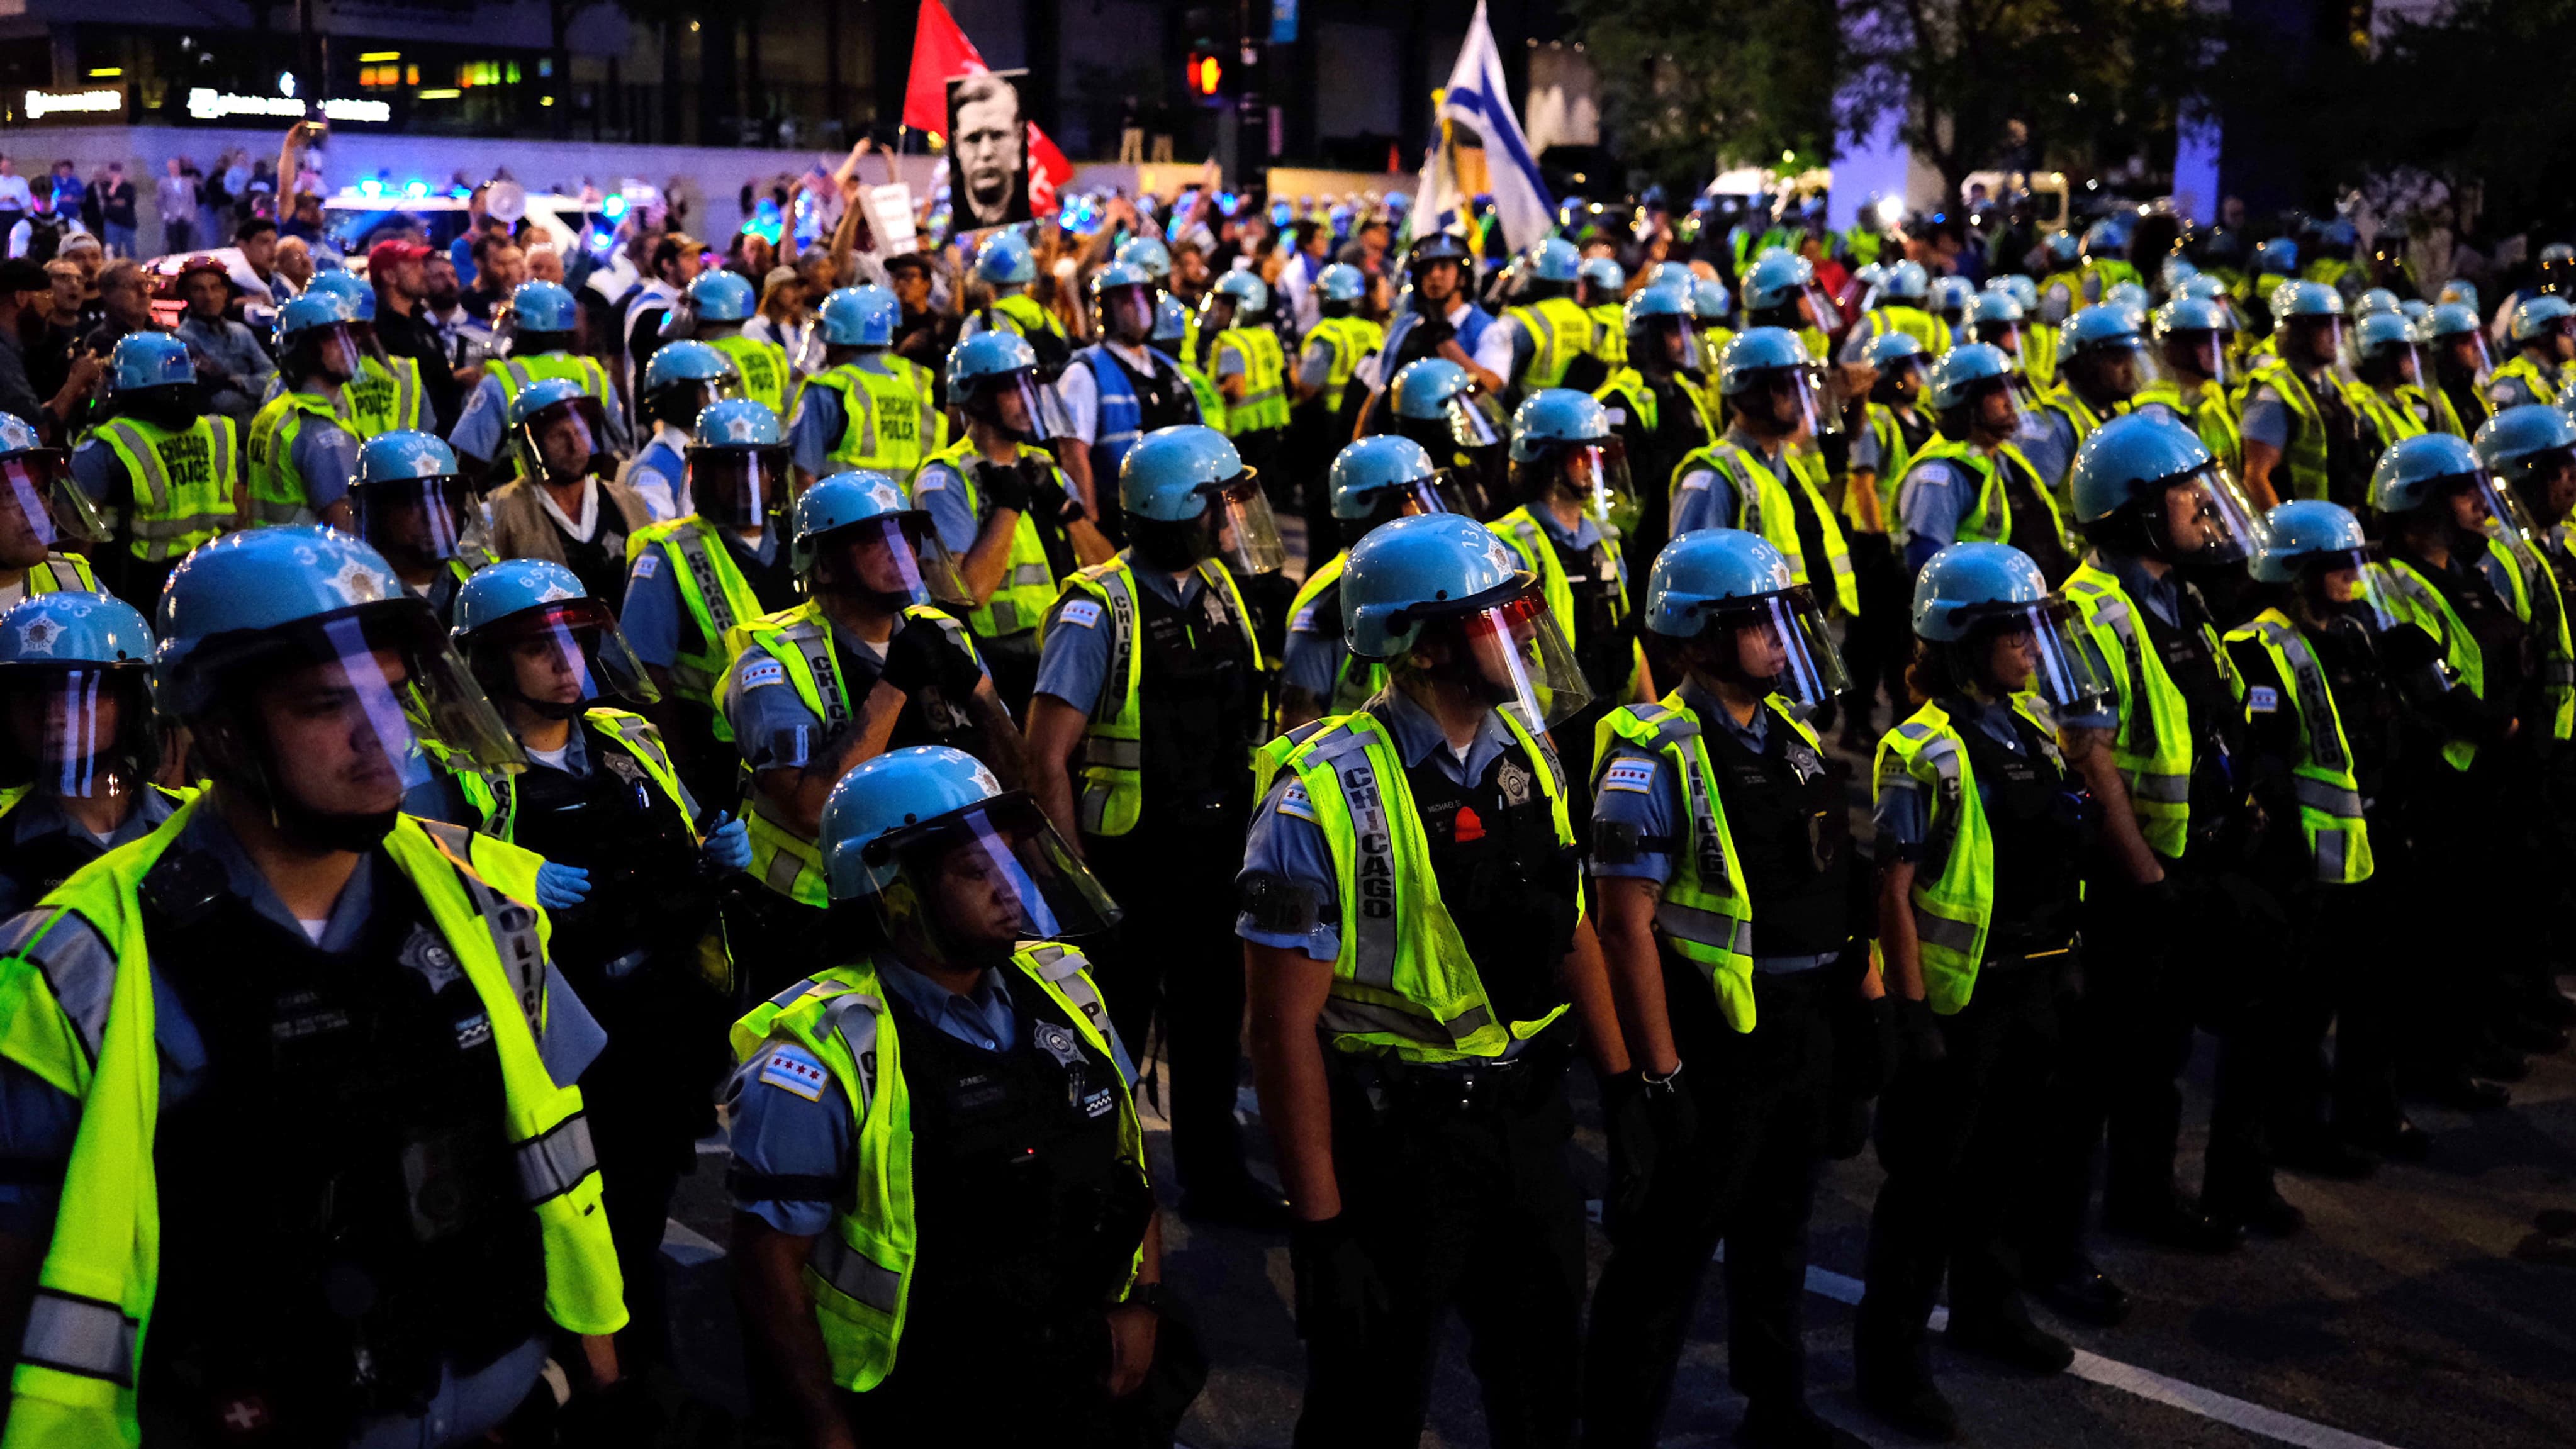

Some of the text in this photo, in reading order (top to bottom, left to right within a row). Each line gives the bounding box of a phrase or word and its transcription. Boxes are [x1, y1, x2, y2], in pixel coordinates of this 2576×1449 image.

[518, 567, 571, 588] 6572
[1112, 595, 1131, 699] CHICAGO
[812, 656, 847, 736] CHICA
[1343, 767, 1391, 919] CHICAGO
